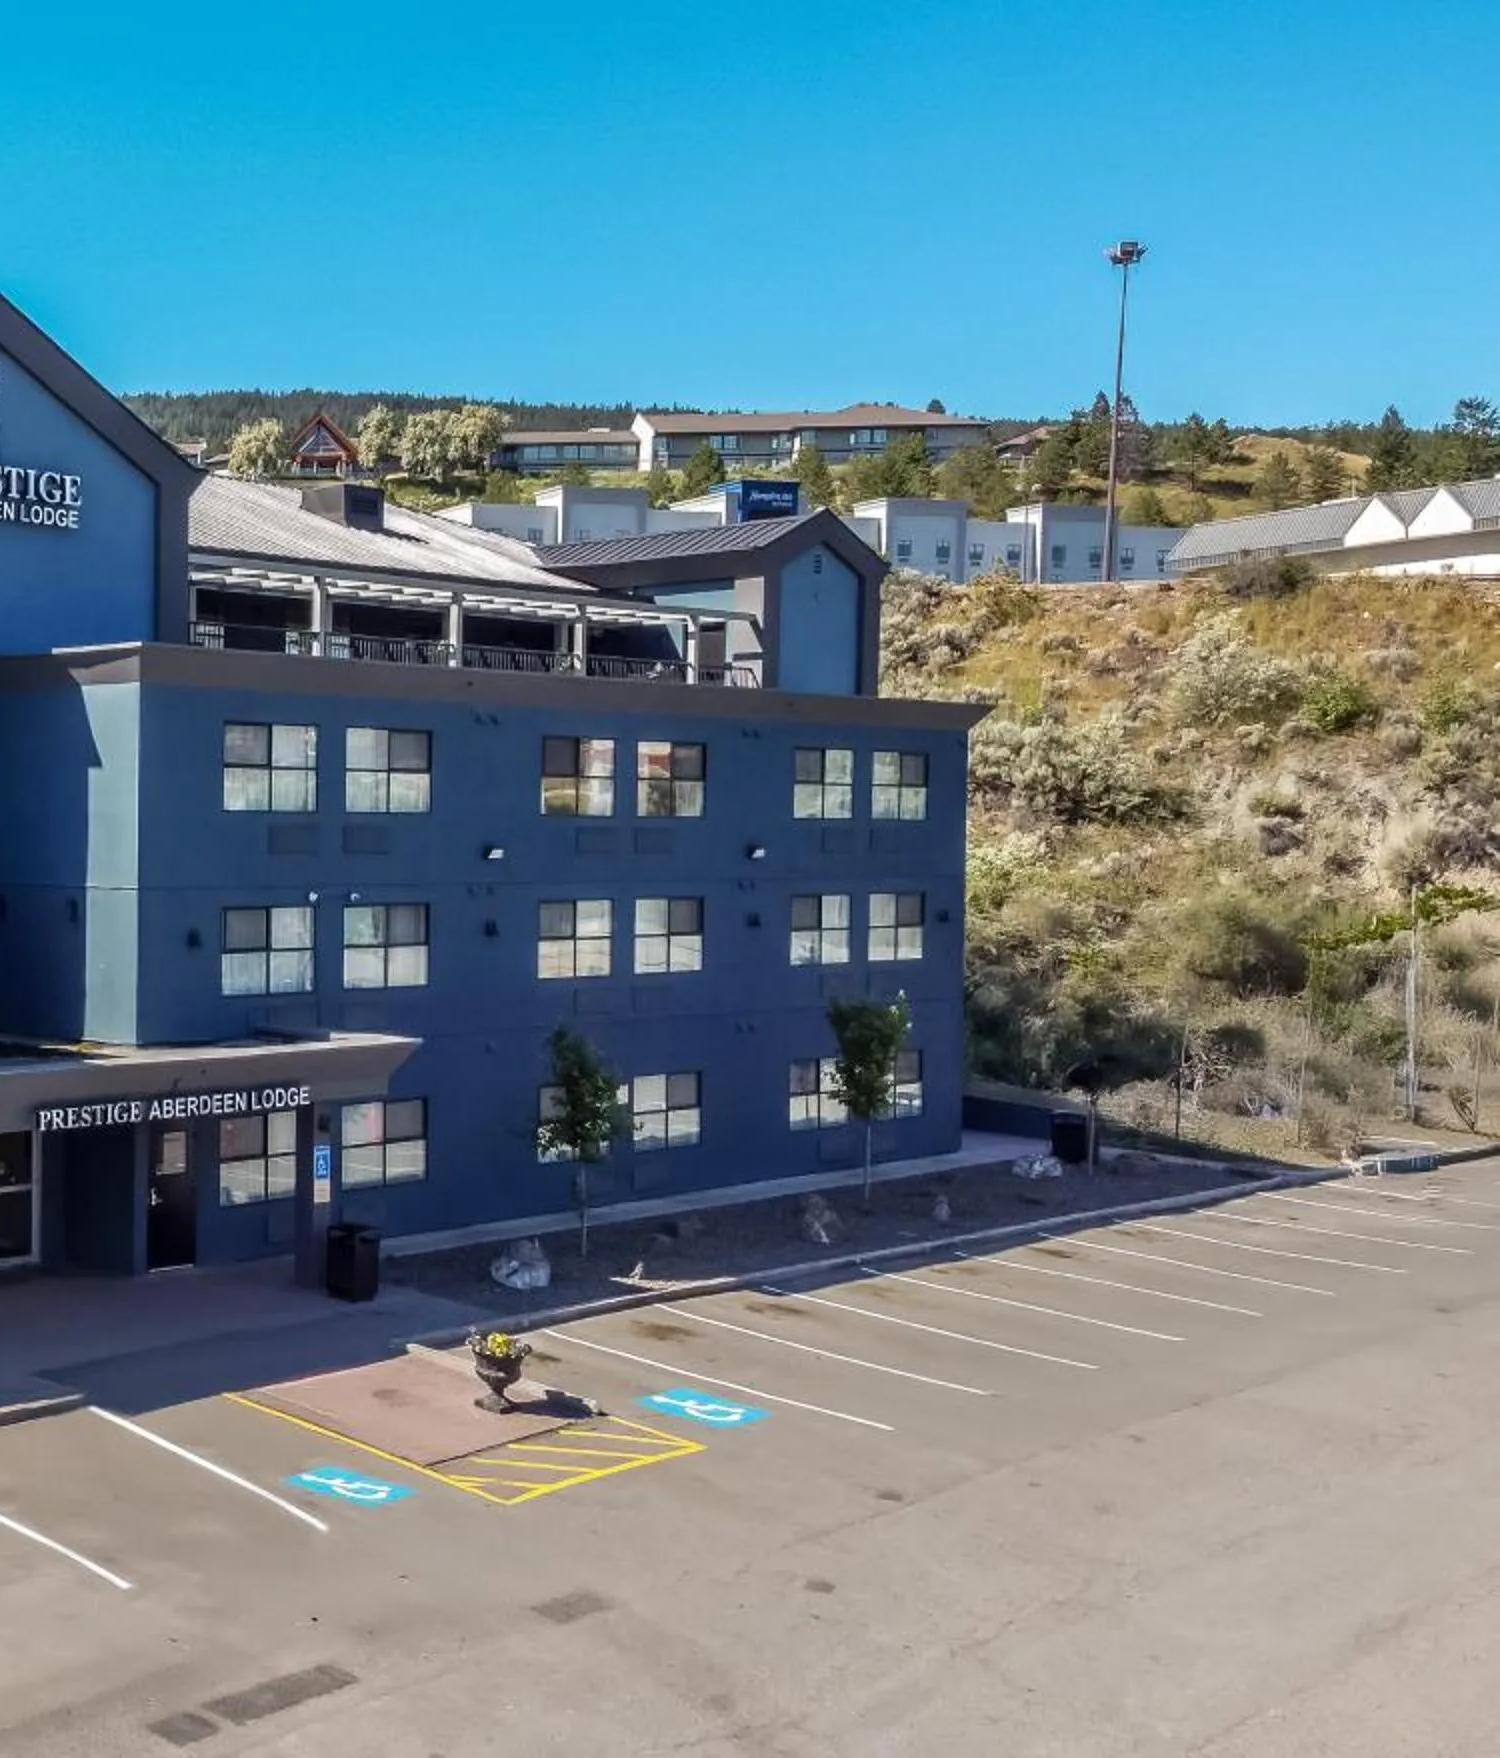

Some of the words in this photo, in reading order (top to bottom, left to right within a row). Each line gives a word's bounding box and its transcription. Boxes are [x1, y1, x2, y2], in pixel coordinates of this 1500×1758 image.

[19, 503, 79, 529] LODGE
[38, 1101, 143, 1131] PRESTIGE
[149, 1091, 247, 1120] ABERDEEN
[251, 1085, 311, 1110] LODGE
